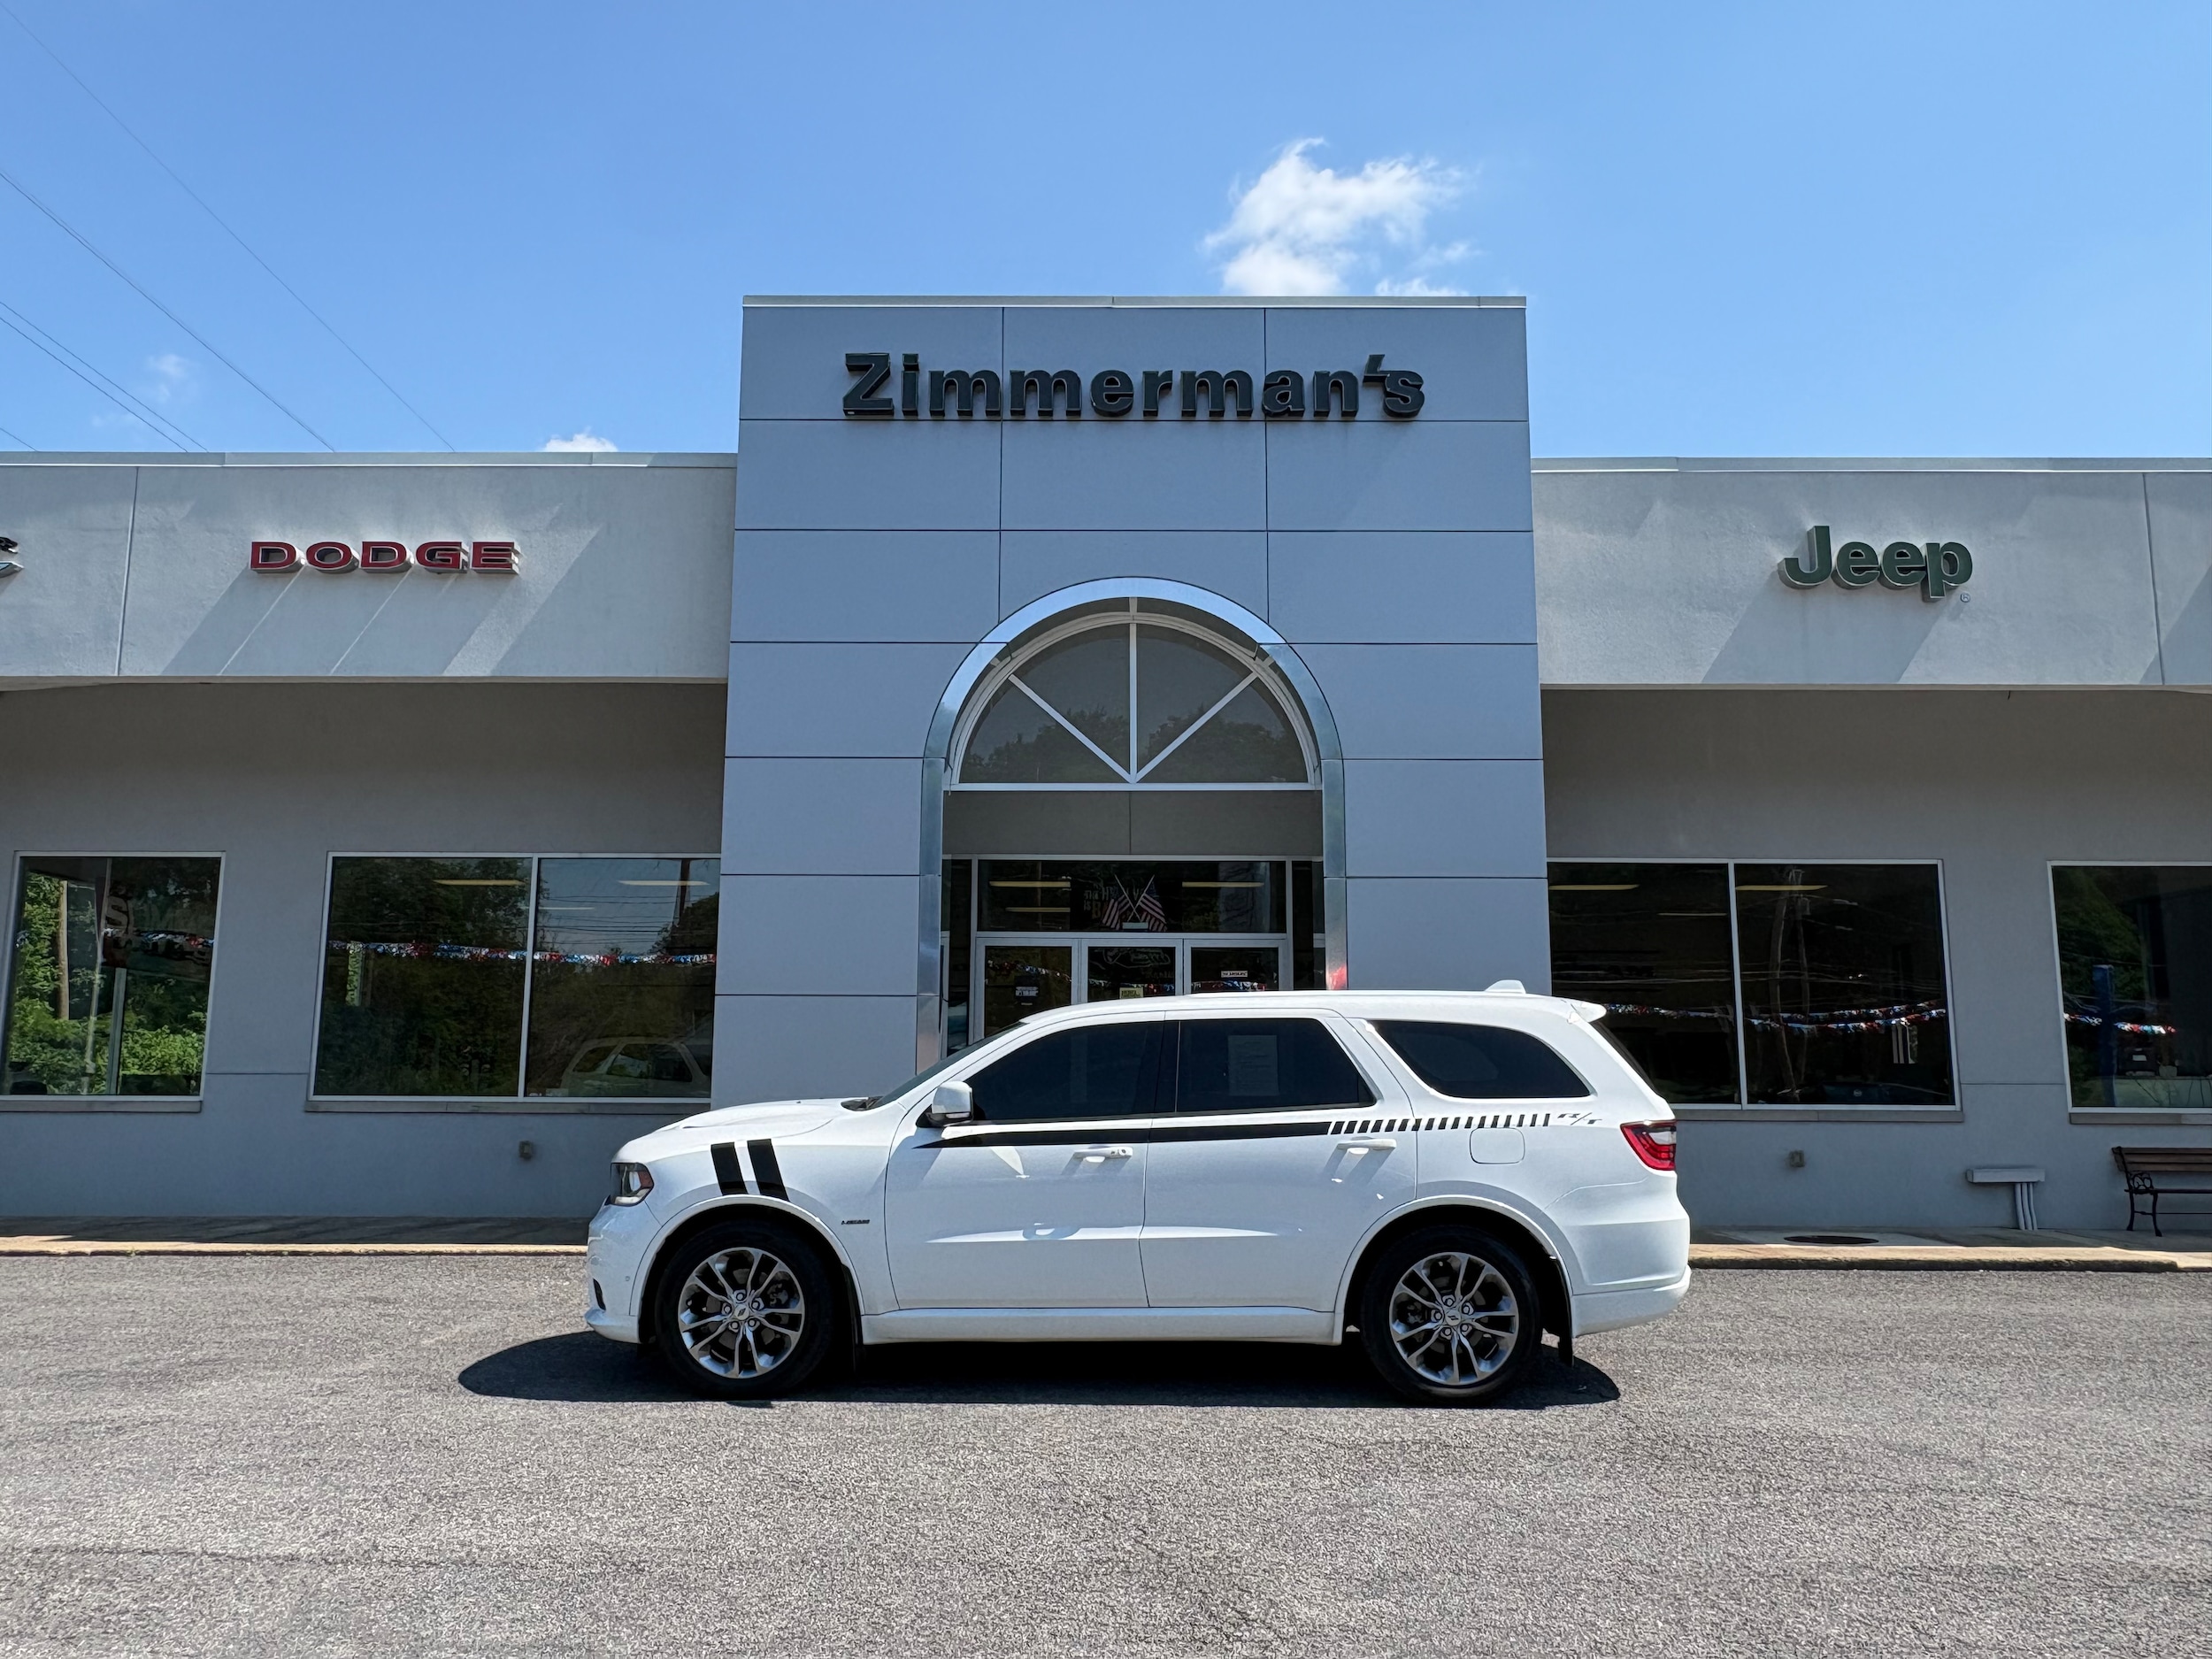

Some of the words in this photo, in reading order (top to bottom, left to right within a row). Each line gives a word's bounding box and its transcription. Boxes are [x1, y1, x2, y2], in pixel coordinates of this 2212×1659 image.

[842, 352, 1426, 419] Zimmerman's
[250, 541, 520, 573] DODGE
[1778, 526, 1973, 602] Jeep
